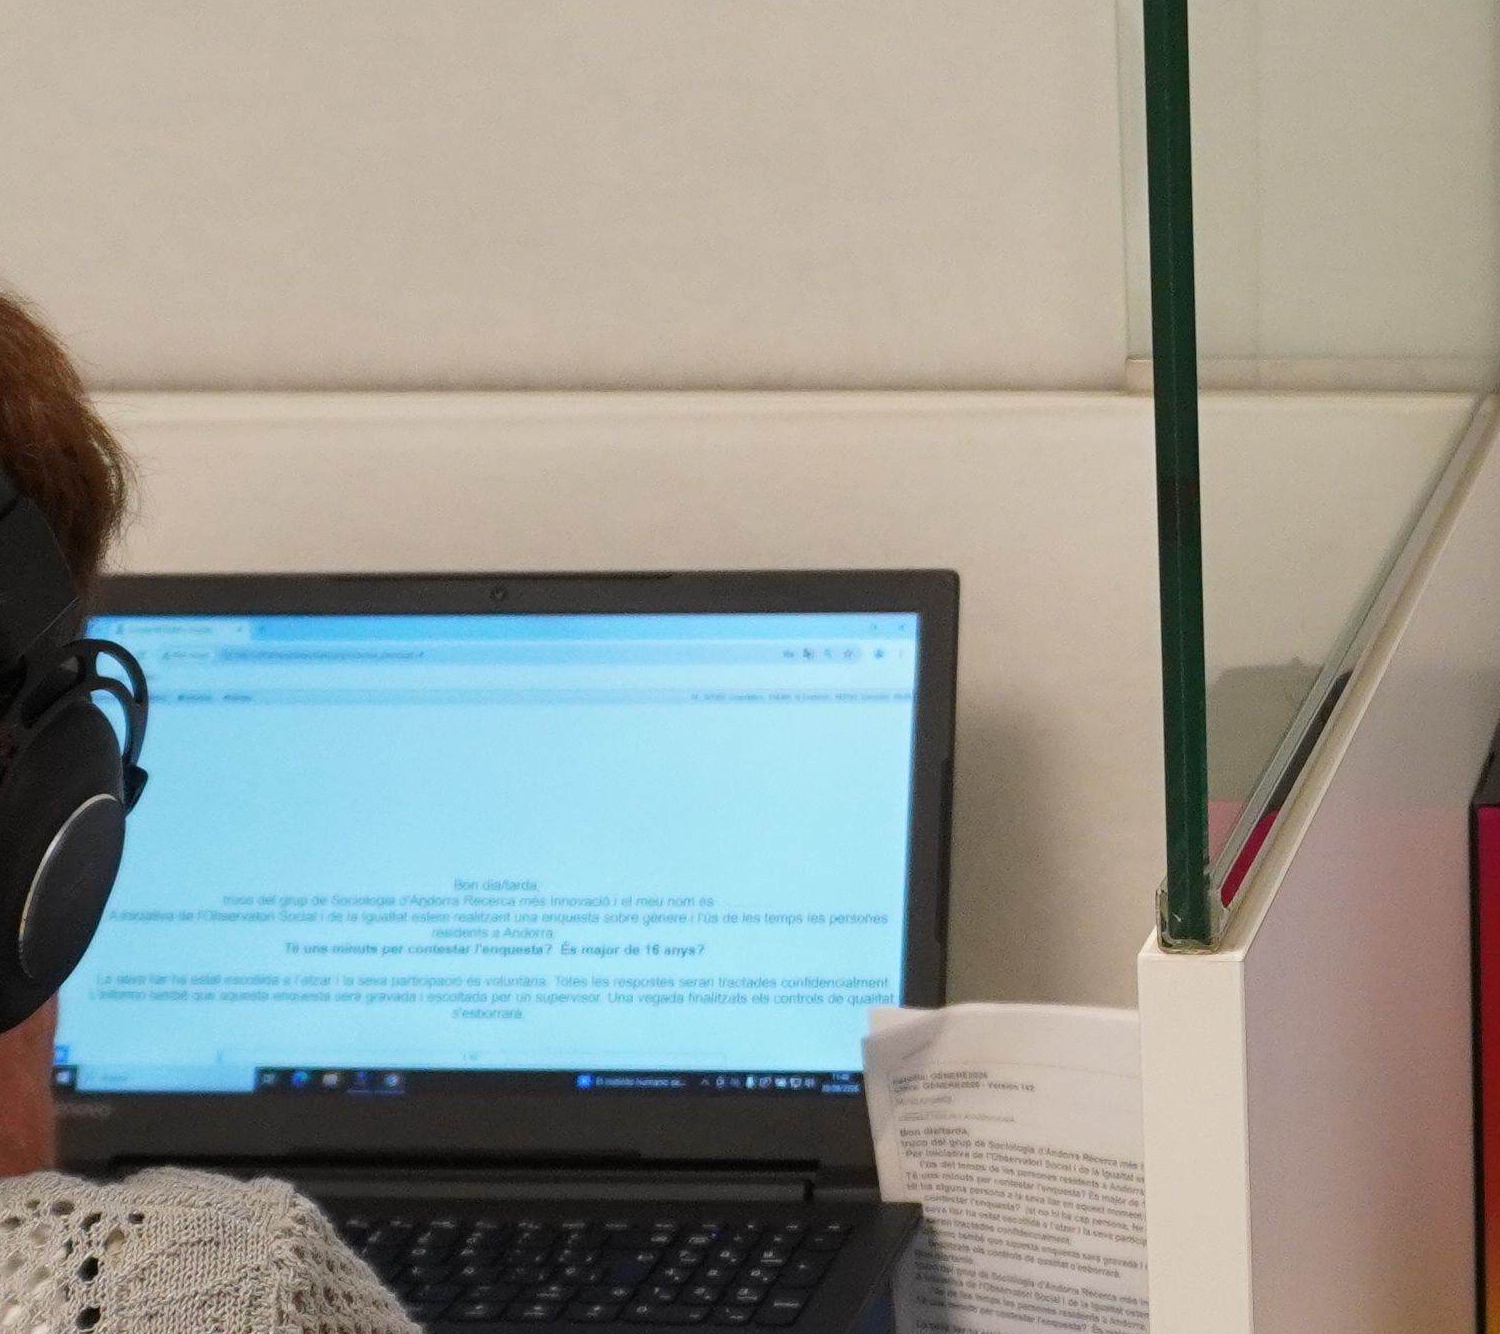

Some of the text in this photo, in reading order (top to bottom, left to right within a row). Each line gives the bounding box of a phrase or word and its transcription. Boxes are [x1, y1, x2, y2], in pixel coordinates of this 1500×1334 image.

[454, 878, 478, 890] Bon
[280, 896, 308, 909] grup
[311, 895, 327, 906] de
[331, 895, 396, 909] Sociologia
[399, 895, 460, 907] d'Andorra
[464, 896, 517, 907] Recerca
[520, 895, 546, 907] més
[550, 896, 610, 908] Innovació
[621, 896, 633, 907] el
[636, 898, 664, 908] meu
[667, 898, 695, 908] nom
[278, 910, 317, 922] Social
[327, 911, 343, 922] de
[346, 912, 358, 922] la
[362, 912, 408, 925] Igualtat
[411, 912, 449, 924] estem
[453, 912, 511, 924] realitzant
[515, 914, 538, 924] una
[541, 914, 600, 927] enquesta
[603, 912, 640, 924] sobre
[722, 912, 739, 924] de
[742, 912, 761, 924] les
[764, 913, 803, 927] temps
[806, 913, 826, 924] les
[829, 914, 889, 927] persones
[432, 927, 489, 939] residents
[303, 944, 328, 954] uns
[331, 942, 378, 954] minuts
[381, 945, 403, 957] per
[407, 943, 470, 955] contestar
[474, 942, 553, 958] l'enquesta?
[561, 940, 578, 955] És
[581, 944, 620, 959] major
[623, 944, 641, 956] de
[645, 944, 660, 956] 16
[663, 944, 705, 959] anys?
[343, 976, 355, 987] la
[358, 978, 388, 987] seva
[391, 976, 463, 990] participació
[555, 976, 588, 988] Totes
[592, 976, 610, 988] les
[613, 977, 676, 990] respostes
[679, 979, 715, 988] seran
[718, 976, 777, 988] tractades
[272, 992, 331, 1005] enquesta
[365, 992, 416, 1005] gravada
[427, 992, 488, 1003] escoltada
[491, 994, 511, 1006] per
[514, 994, 531, 1003] un
[607, 992, 634, 1004] Una
[638, 993, 684, 1007] vegada
[687, 992, 748, 1004] finalitzats
[751, 992, 770, 1004] els
[773, 992, 824, 1004] controls
[827, 992, 845, 1004] de
[848, 992, 894, 1007] qualitat
